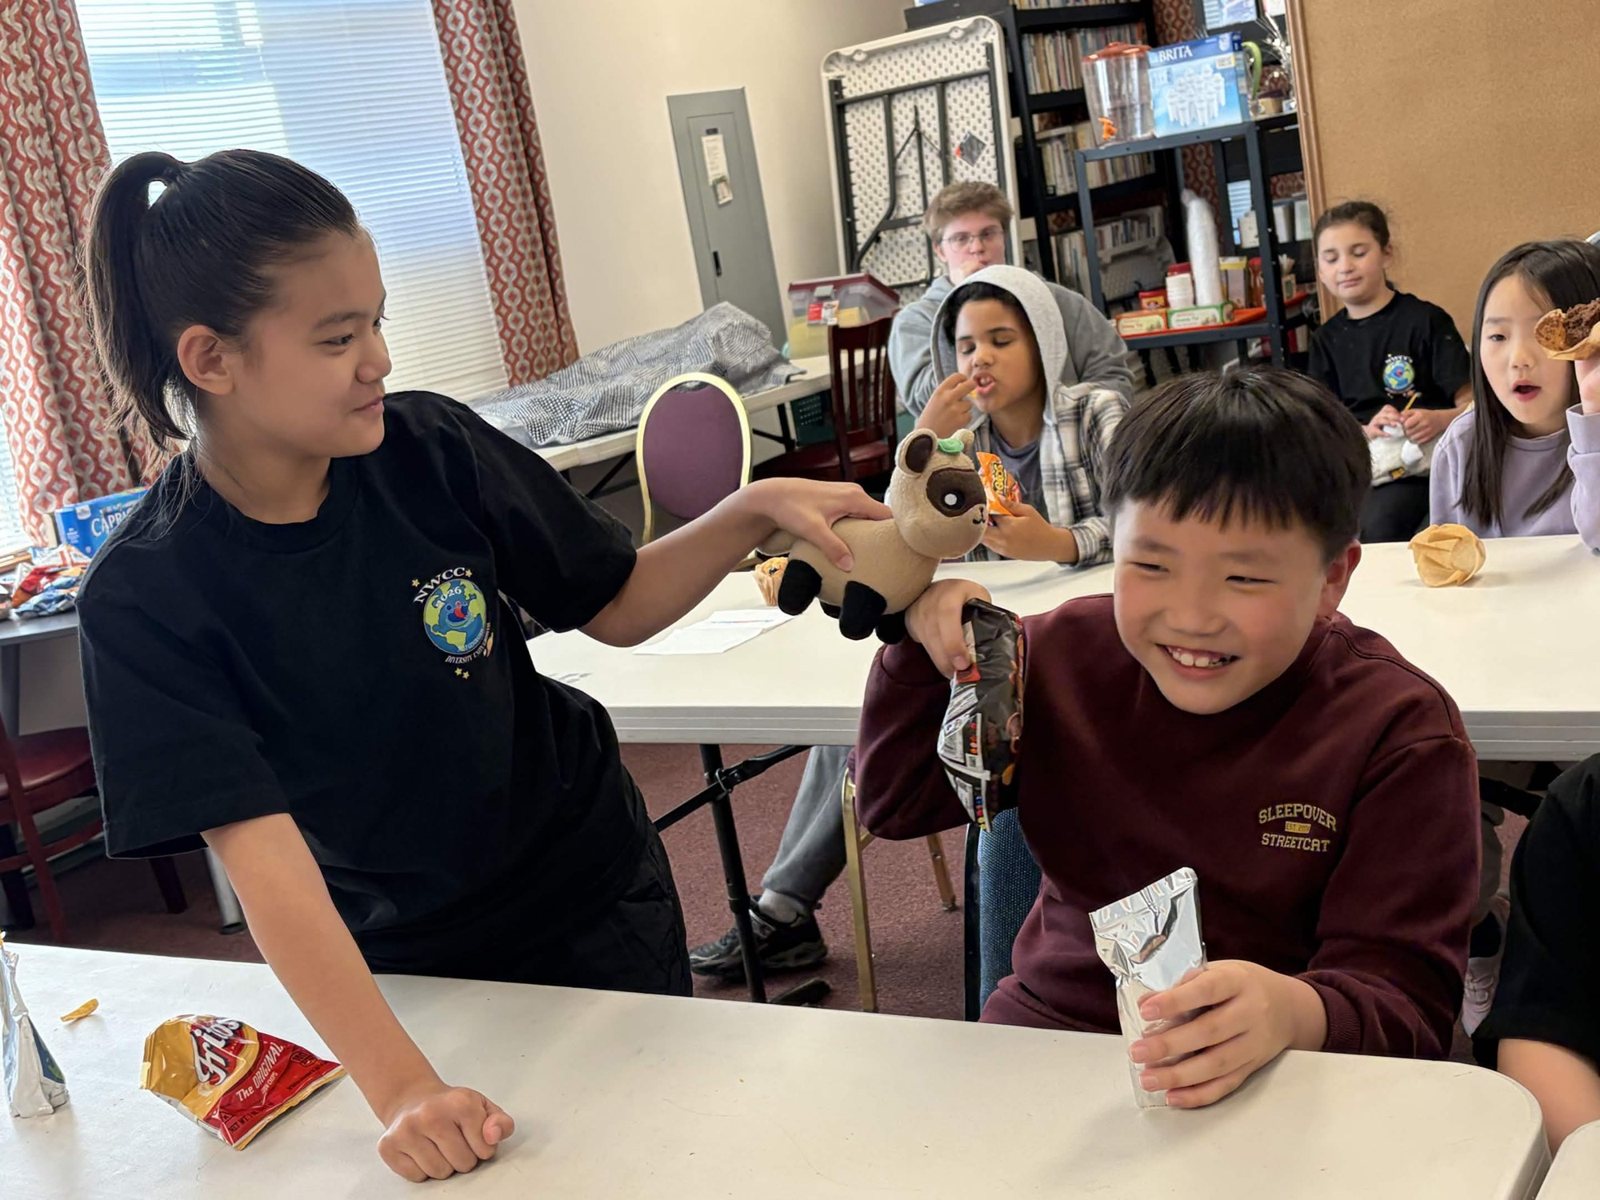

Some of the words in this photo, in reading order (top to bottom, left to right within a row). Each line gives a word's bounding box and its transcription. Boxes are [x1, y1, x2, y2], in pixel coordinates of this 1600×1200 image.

[1158, 45, 1193, 63] BRITA
[413, 567, 465, 604] NWCC
[1258, 803, 1336, 832] SLEEPOVER
[1261, 833, 1330, 852] STREETCAT
[191, 1020, 240, 1086] Fritos
[235, 1085, 255, 1102] The
[252, 1041, 284, 1088] ORIGINAL
